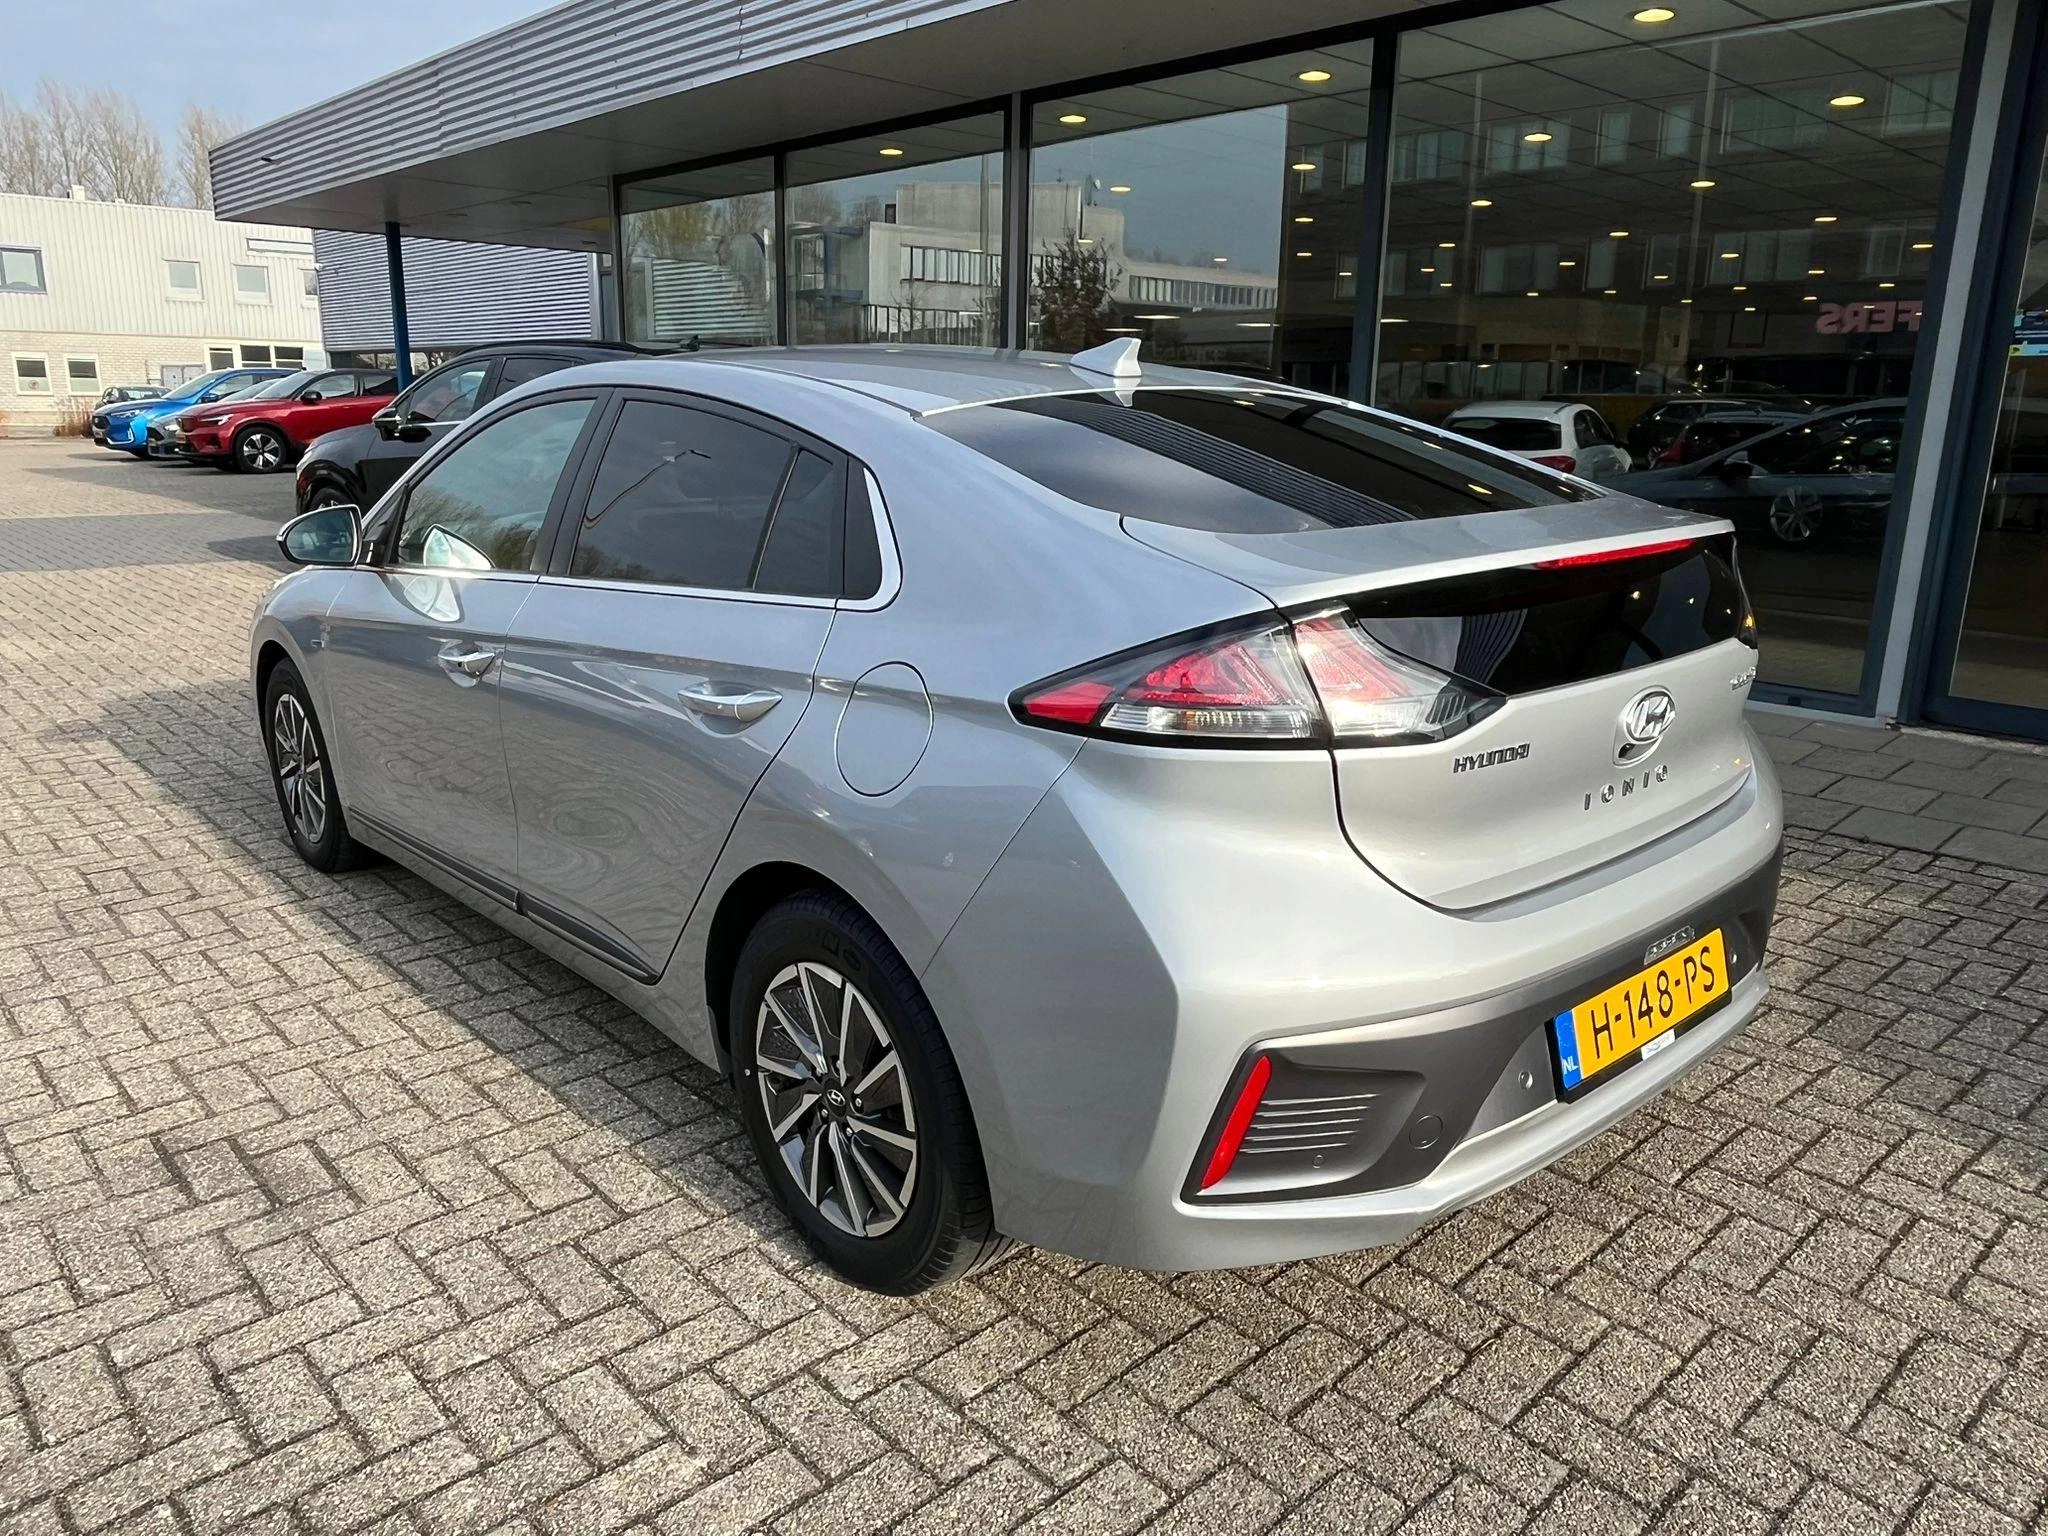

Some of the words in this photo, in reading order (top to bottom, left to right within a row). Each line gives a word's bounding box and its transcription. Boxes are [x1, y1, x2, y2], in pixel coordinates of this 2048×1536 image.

[1453, 743, 1530, 773] HYUNDAI
[1584, 764, 1668, 811] IONIQ
[1591, 946, 1715, 1059] H-148-PS
[1561, 1056, 1579, 1075] NL
